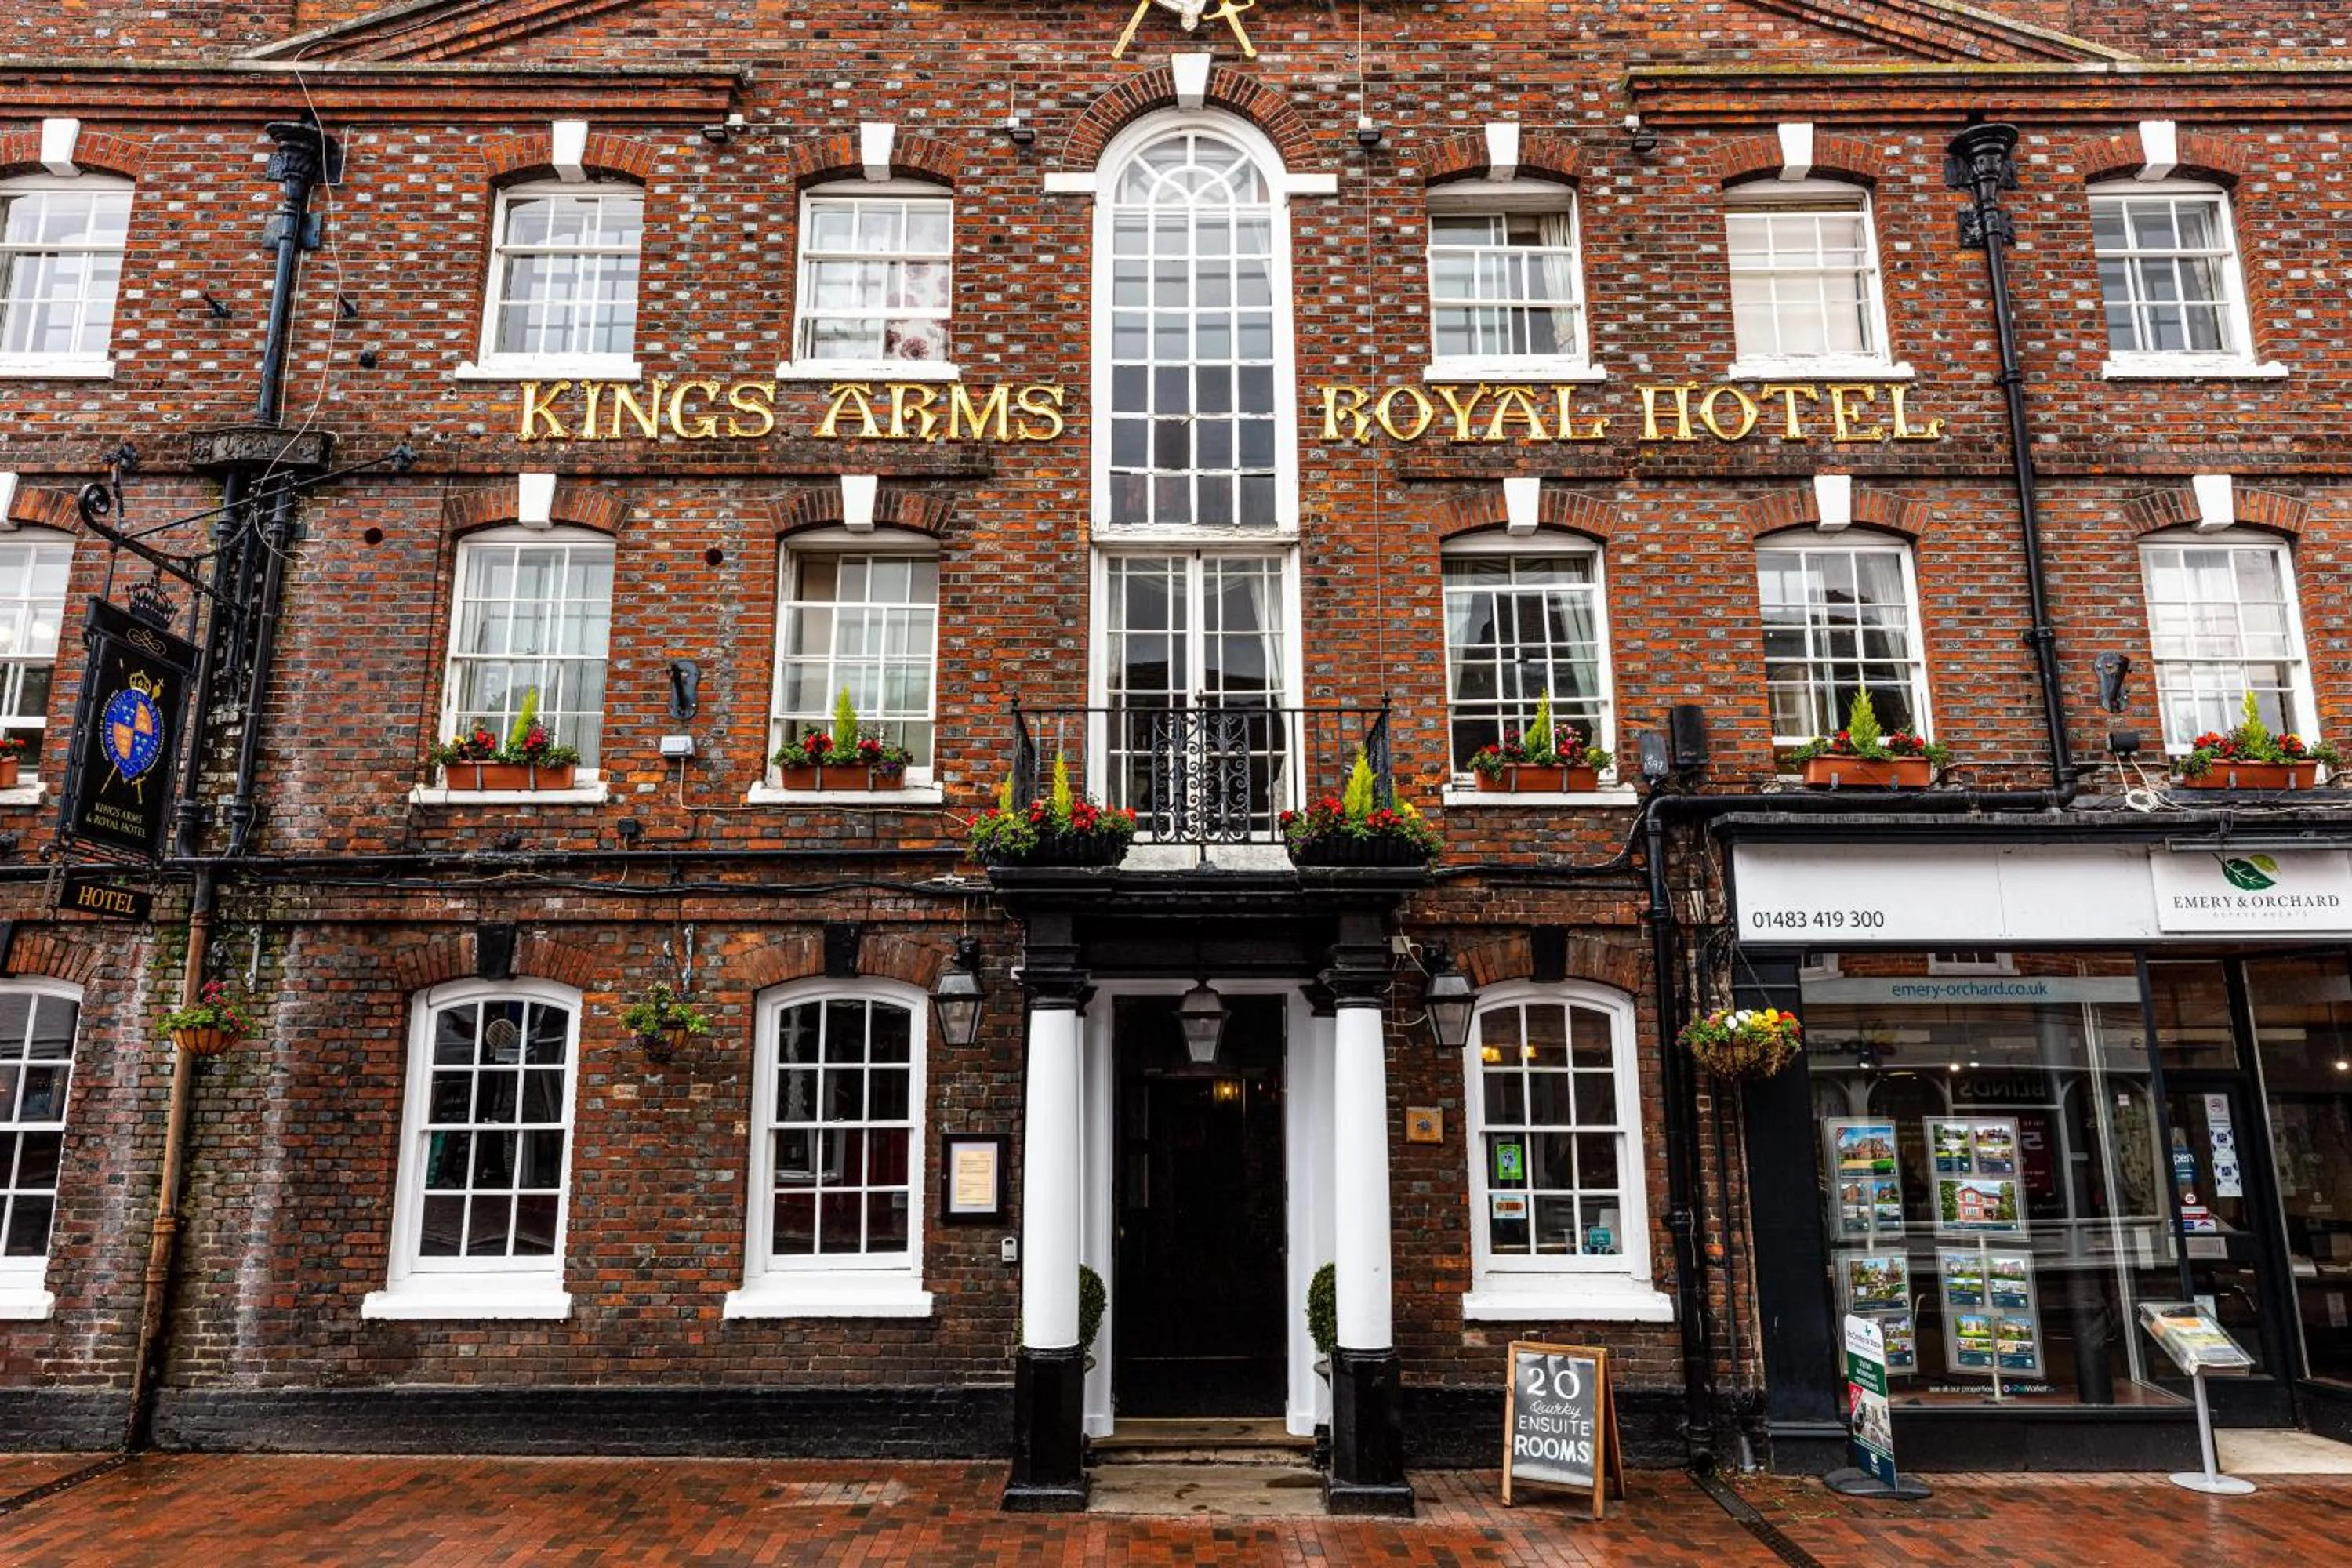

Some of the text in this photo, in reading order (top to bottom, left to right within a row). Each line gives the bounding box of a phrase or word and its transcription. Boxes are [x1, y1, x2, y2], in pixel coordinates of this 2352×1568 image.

[518, 379, 1065, 443] KINGS ARMS
[1317, 380, 1944, 445] ROYAL HOTEL
[93, 801, 143, 824] KINGS ARMS
[85, 811, 147, 838] & ROYAL HOTEL
[77, 884, 136, 916] HOTEL
[2173, 895, 2340, 909] EMERY & ORCHARD
[1752, 910, 1885, 928] 01483 419 300
[1891, 981, 2048, 1000] emery-orchard.co.uk
[2173, 1153, 2194, 1167] pen
[1526, 1367, 1581, 1399] 20
[1530, 1399, 1581, 1418] Quirky
[1519, 1415, 1591, 1436] ENSUITE
[1515, 1434, 1590, 1464] ROOMS
